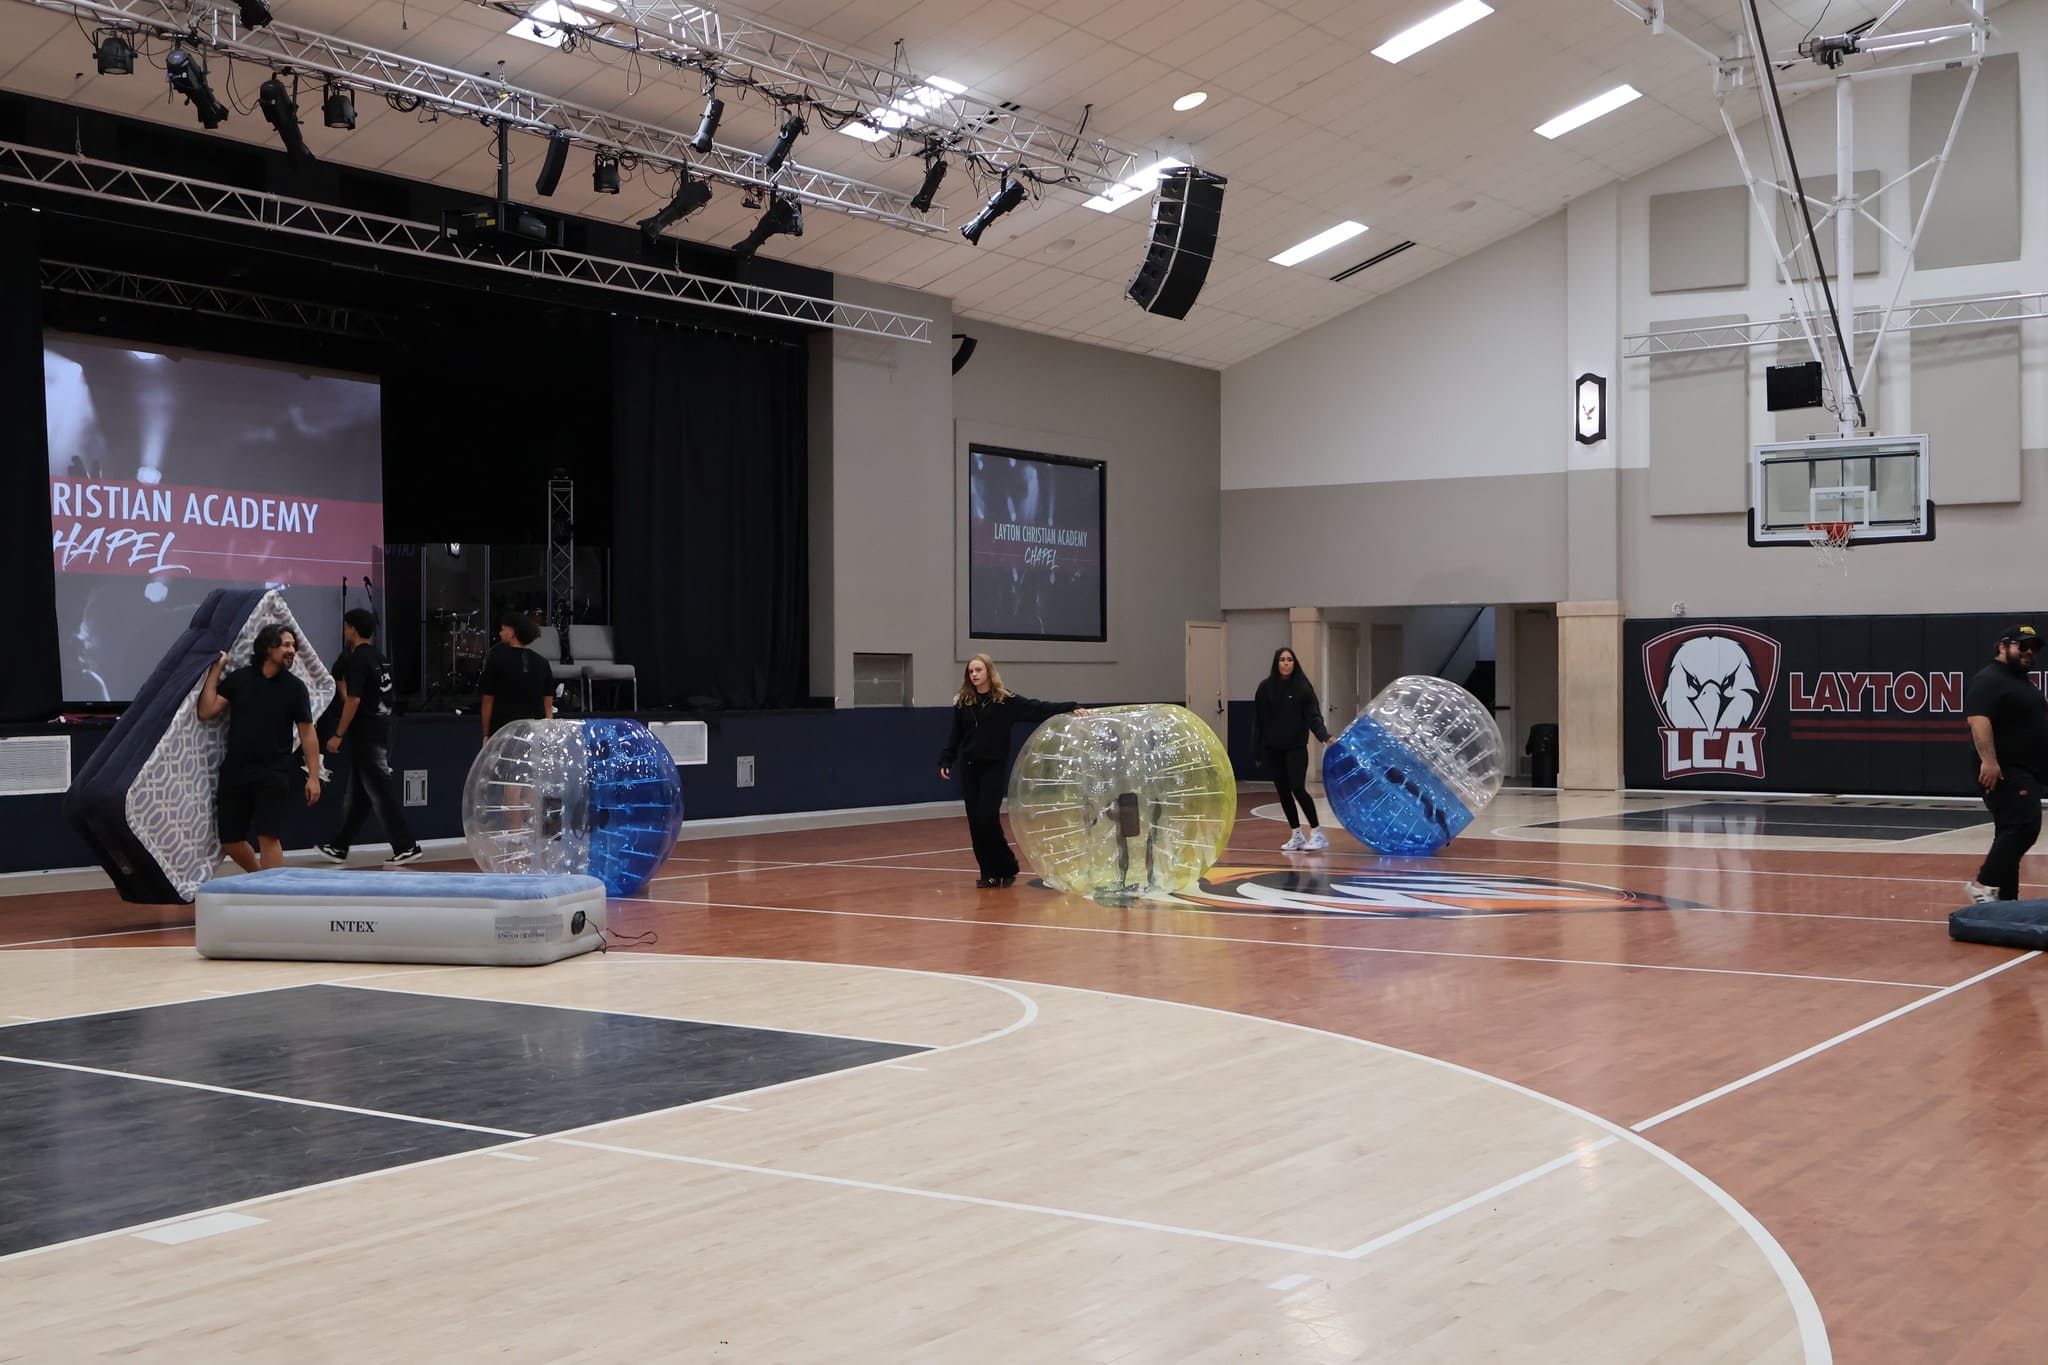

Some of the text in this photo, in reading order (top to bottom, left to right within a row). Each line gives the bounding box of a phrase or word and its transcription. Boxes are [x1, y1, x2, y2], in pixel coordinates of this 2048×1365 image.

[53, 482, 319, 534] RISTIAN ACADEMY
[994, 522, 1087, 547] LAYTON CHRISTIAN ACADEMY
[1024, 546, 1059, 570] CHAPEL
[1789, 671, 1964, 713] LAYTON
[1663, 730, 1758, 772] LCA
[330, 920, 375, 933] INTEX
